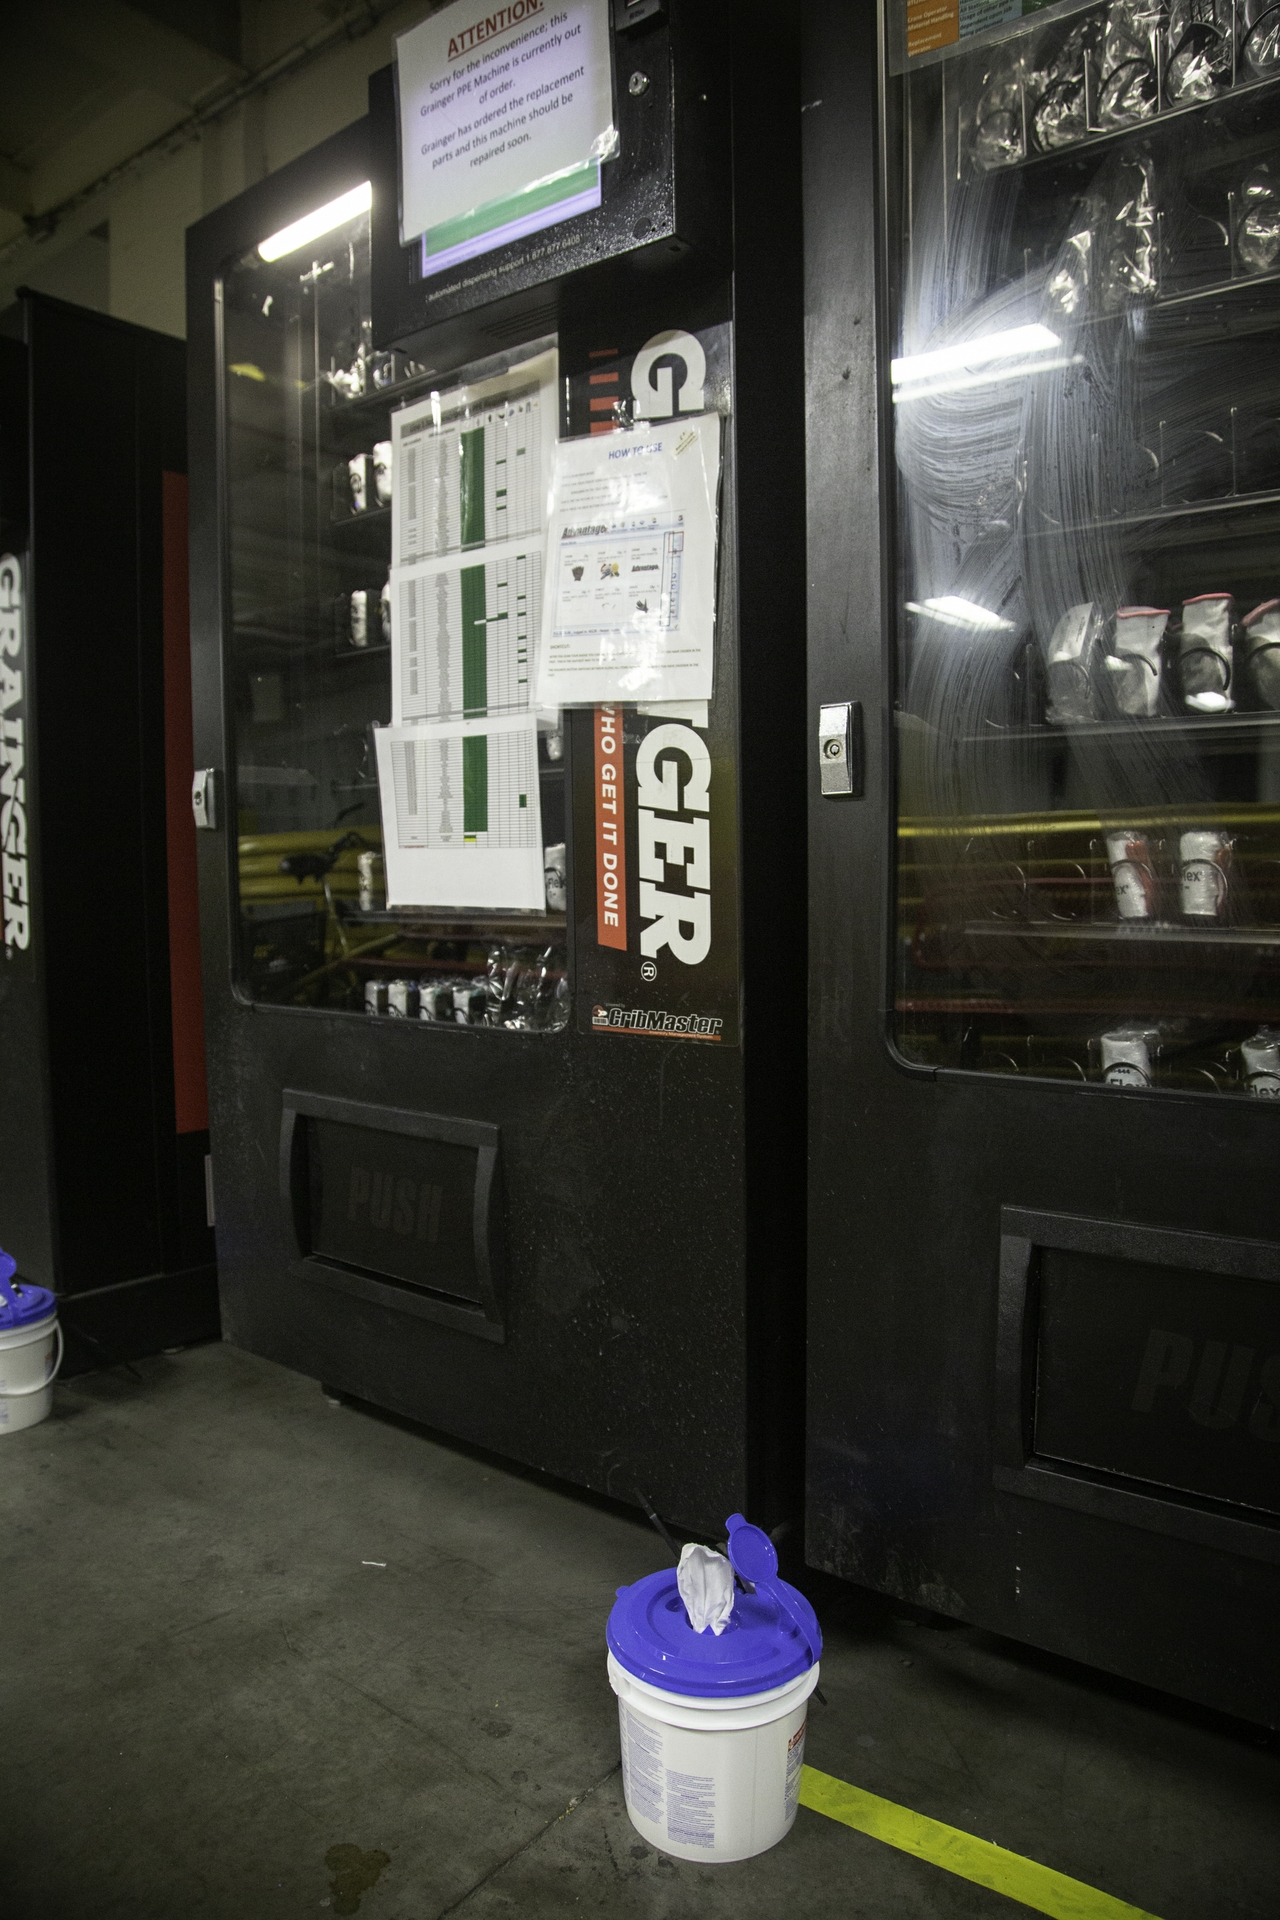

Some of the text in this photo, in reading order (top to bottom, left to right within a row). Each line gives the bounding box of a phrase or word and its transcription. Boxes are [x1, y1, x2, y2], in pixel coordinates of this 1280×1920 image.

[447, 0, 544, 58] ATTENTION
[908, 11, 955, 31] Material Handling
[923, 6, 948, 18] Operator
[420, 24, 582, 117] Grainger PPE Machine is currently out
[429, 12, 568, 94] Sorry for the inconvenience; this
[420, 66, 585, 155] Grainger has ordered the replacement
[478, 79, 516, 105] of order.
[432, 92, 574, 169] parts and this machine should be
[469, 134, 532, 167] repaired soon.
[461, 268, 498, 287] dispensing
[498, 256, 525, 274] support
[608, 447, 631, 459] HOW
[632, 445, 645, 455] TO
[601, 763, 617, 815] GET
[602, 822, 618, 846] IT
[603, 853, 619, 927] DONE
[608, 1008, 723, 1035] CribMaster
[347, 1163, 443, 1244] PUSH
